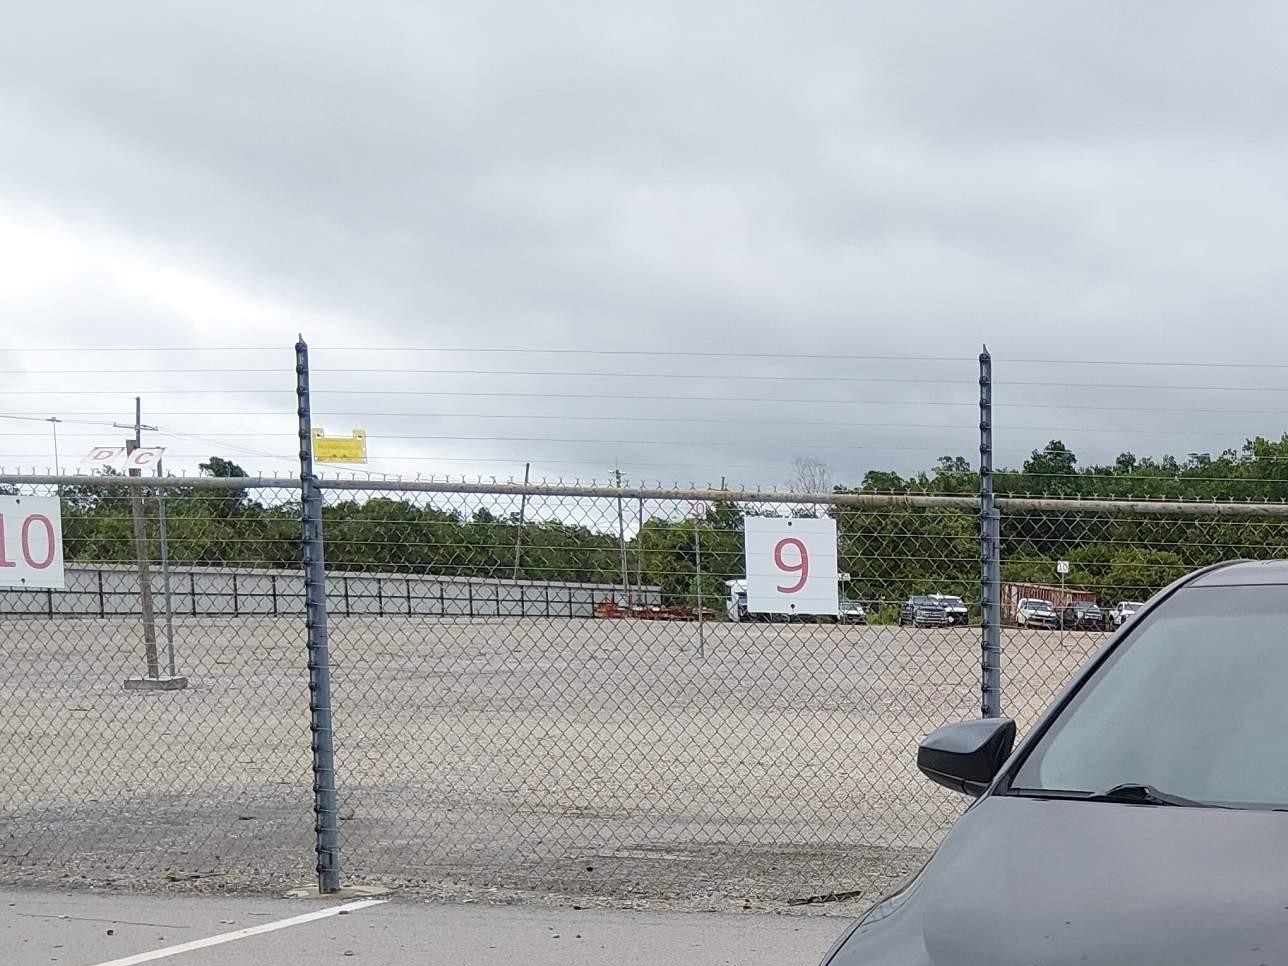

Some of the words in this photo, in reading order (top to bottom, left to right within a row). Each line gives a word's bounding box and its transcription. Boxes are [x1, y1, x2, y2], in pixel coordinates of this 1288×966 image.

[94, 450, 113, 460] D
[135, 452, 154, 465] C
[774, 537, 808, 593] 9
